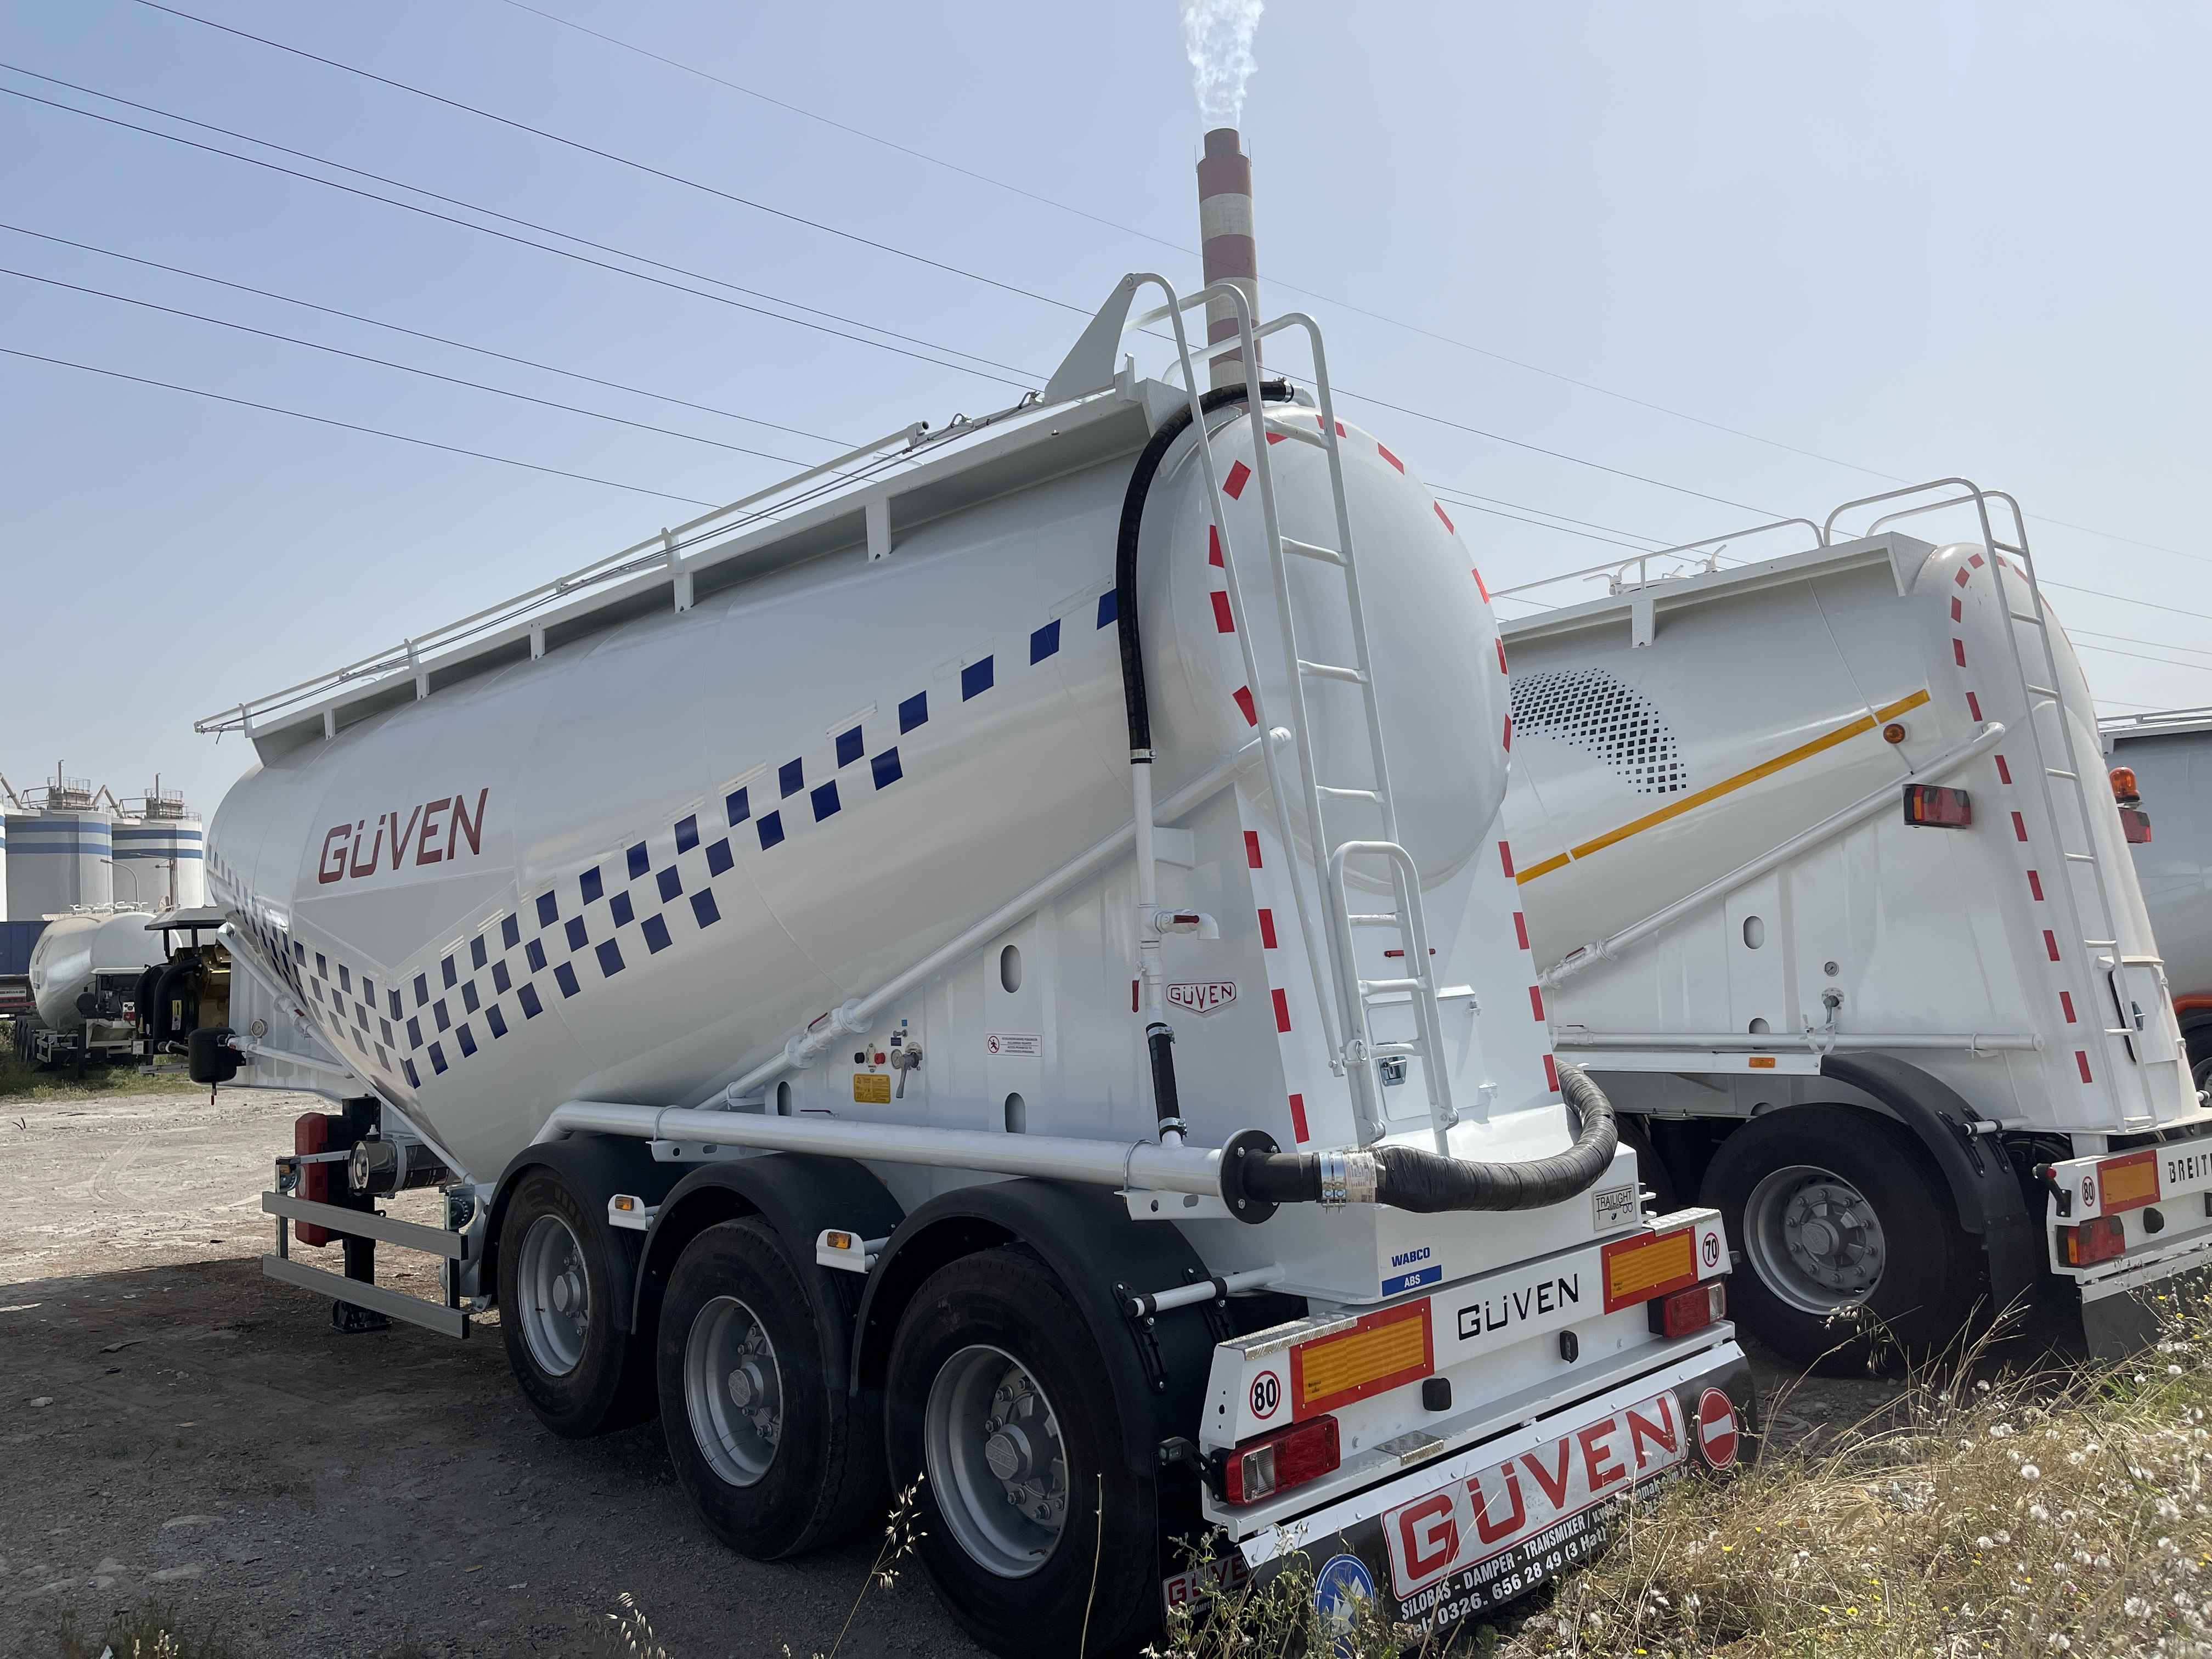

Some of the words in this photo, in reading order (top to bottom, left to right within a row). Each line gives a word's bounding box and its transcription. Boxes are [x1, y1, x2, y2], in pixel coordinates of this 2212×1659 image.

[318, 787, 489, 884] GÜVEN
[1170, 985, 1232, 1009] GÜVEN
[1595, 1190, 1632, 1210] TRAILIGHT
[2084, 1181, 2094, 1201] 80
[1391, 1246, 1431, 1267] WABCO
[1705, 1238, 1718, 1261] 70
[1403, 1273, 1421, 1289] ABS
[1457, 1273, 1579, 1341] GÜVEN
[1254, 1378, 1277, 1412] 80
[1399, 1396, 1678, 1581] GÜVEN
[1463, 1552, 1516, 1590] DAMPER
[1522, 1515, 1586, 1561] TRANSMIXER
[1492, 1576, 1522, 1600] 656
[1523, 1562, 1543, 1584] 28
[1545, 1550, 1562, 1570] 49
[1565, 1542, 1578, 1561] (3
[1580, 1525, 1606, 1552] Hat)
